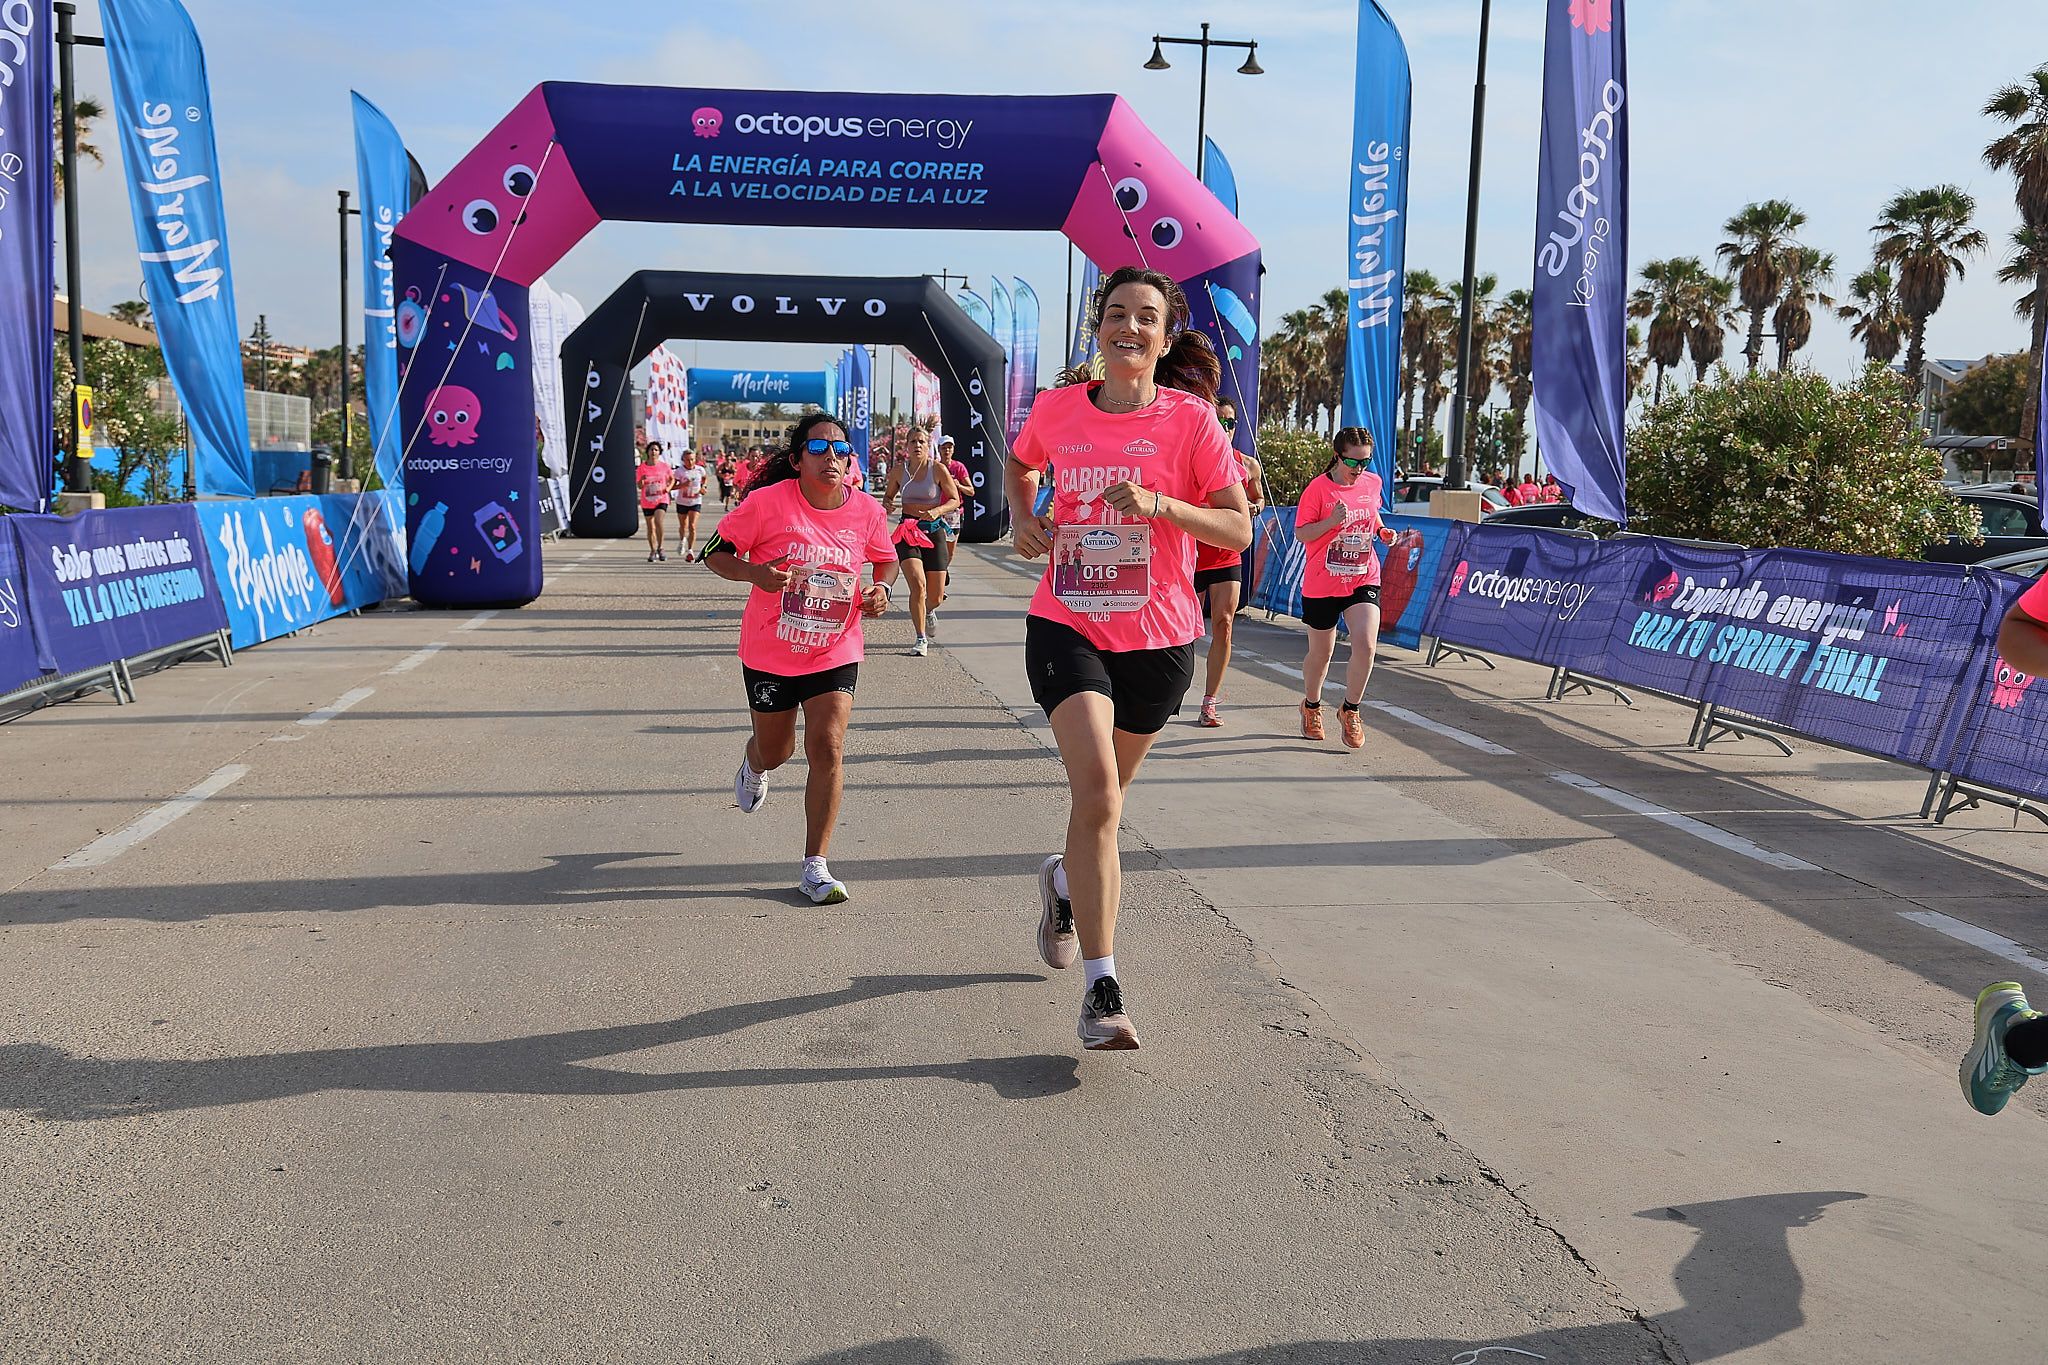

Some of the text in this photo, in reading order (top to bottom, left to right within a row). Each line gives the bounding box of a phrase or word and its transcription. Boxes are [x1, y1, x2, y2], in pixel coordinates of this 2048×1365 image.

[735, 112, 973, 149] octopus energy
[672, 153, 984, 180] LA ENERGÍA PARA CORRER
[669, 180, 988, 205] A LA VELOCIDAD DE LA LUZ
[683, 293, 887, 317] VOLVO
[731, 372, 790, 399] Marlene
[587, 370, 608, 518] VOLVO
[969, 378, 987, 521] VOLVO
[1057, 444, 1093, 455] OYSHO
[408, 457, 513, 474] octopus energy
[1061, 466, 1142, 492] CARRERA
[785, 525, 815, 535] OYSHO
[52, 543, 93, 583] Solo
[123, 536, 169, 571] metros
[164, 531, 192, 565] más
[787, 542, 851, 567] CARRERA
[219, 511, 314, 641] Marlene
[1082, 565, 1118, 580] 016
[62, 587, 90, 627] YA
[85, 583, 114, 623] LO
[109, 576, 141, 617] HAS
[135, 567, 205, 611] CONSEGUIDO
[804, 597, 831, 610] 016
[1063, 600, 1091, 608] OYSHO
[1468, 569, 1595, 622] octopus energy
[1087, 611, 1111, 622] 2026
[1671, 576, 1874, 645] Cogiendo energía
[791, 644, 809, 654] 2026
[1627, 611, 1888, 702] PARA TU SPRINT FINAL
